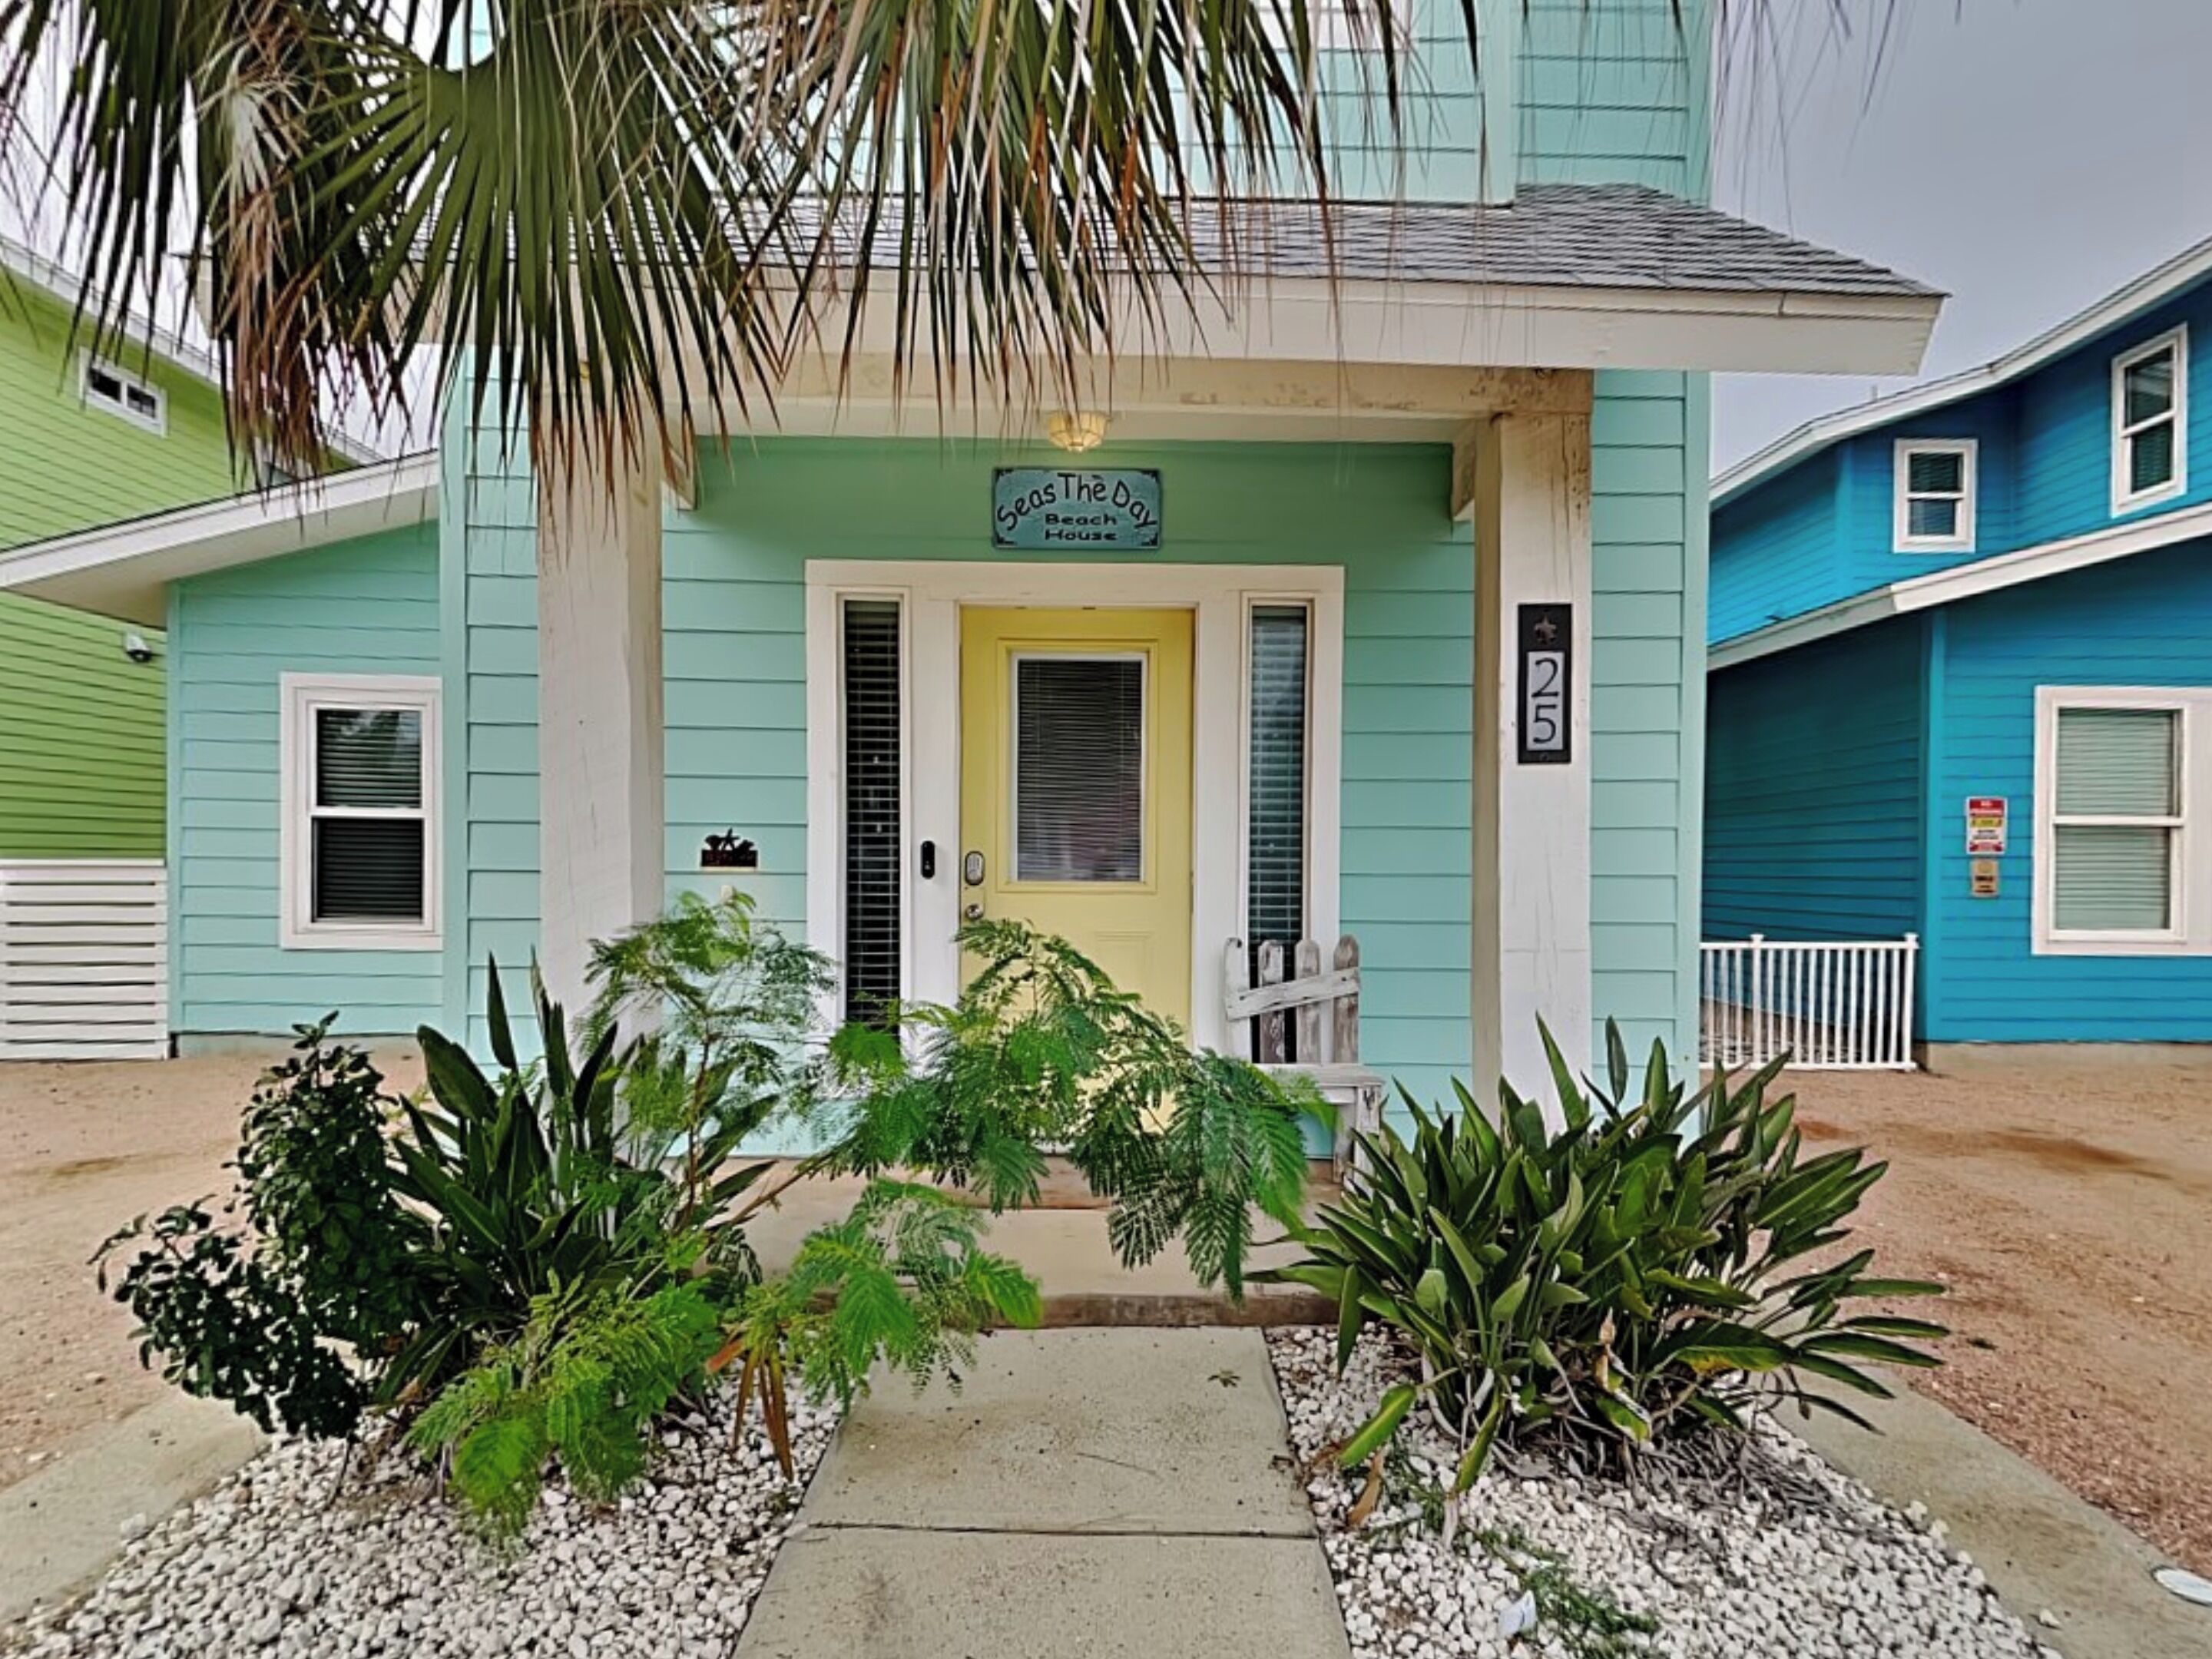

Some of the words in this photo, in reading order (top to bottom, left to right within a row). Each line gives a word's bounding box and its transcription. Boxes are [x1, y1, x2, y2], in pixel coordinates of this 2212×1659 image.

[997, 483, 1056, 531] Seas
[1112, 479, 1157, 529] Day
[1045, 513, 1118, 525] Beach
[1045, 529, 1117, 541] House
[1531, 657, 1559, 743] 25
